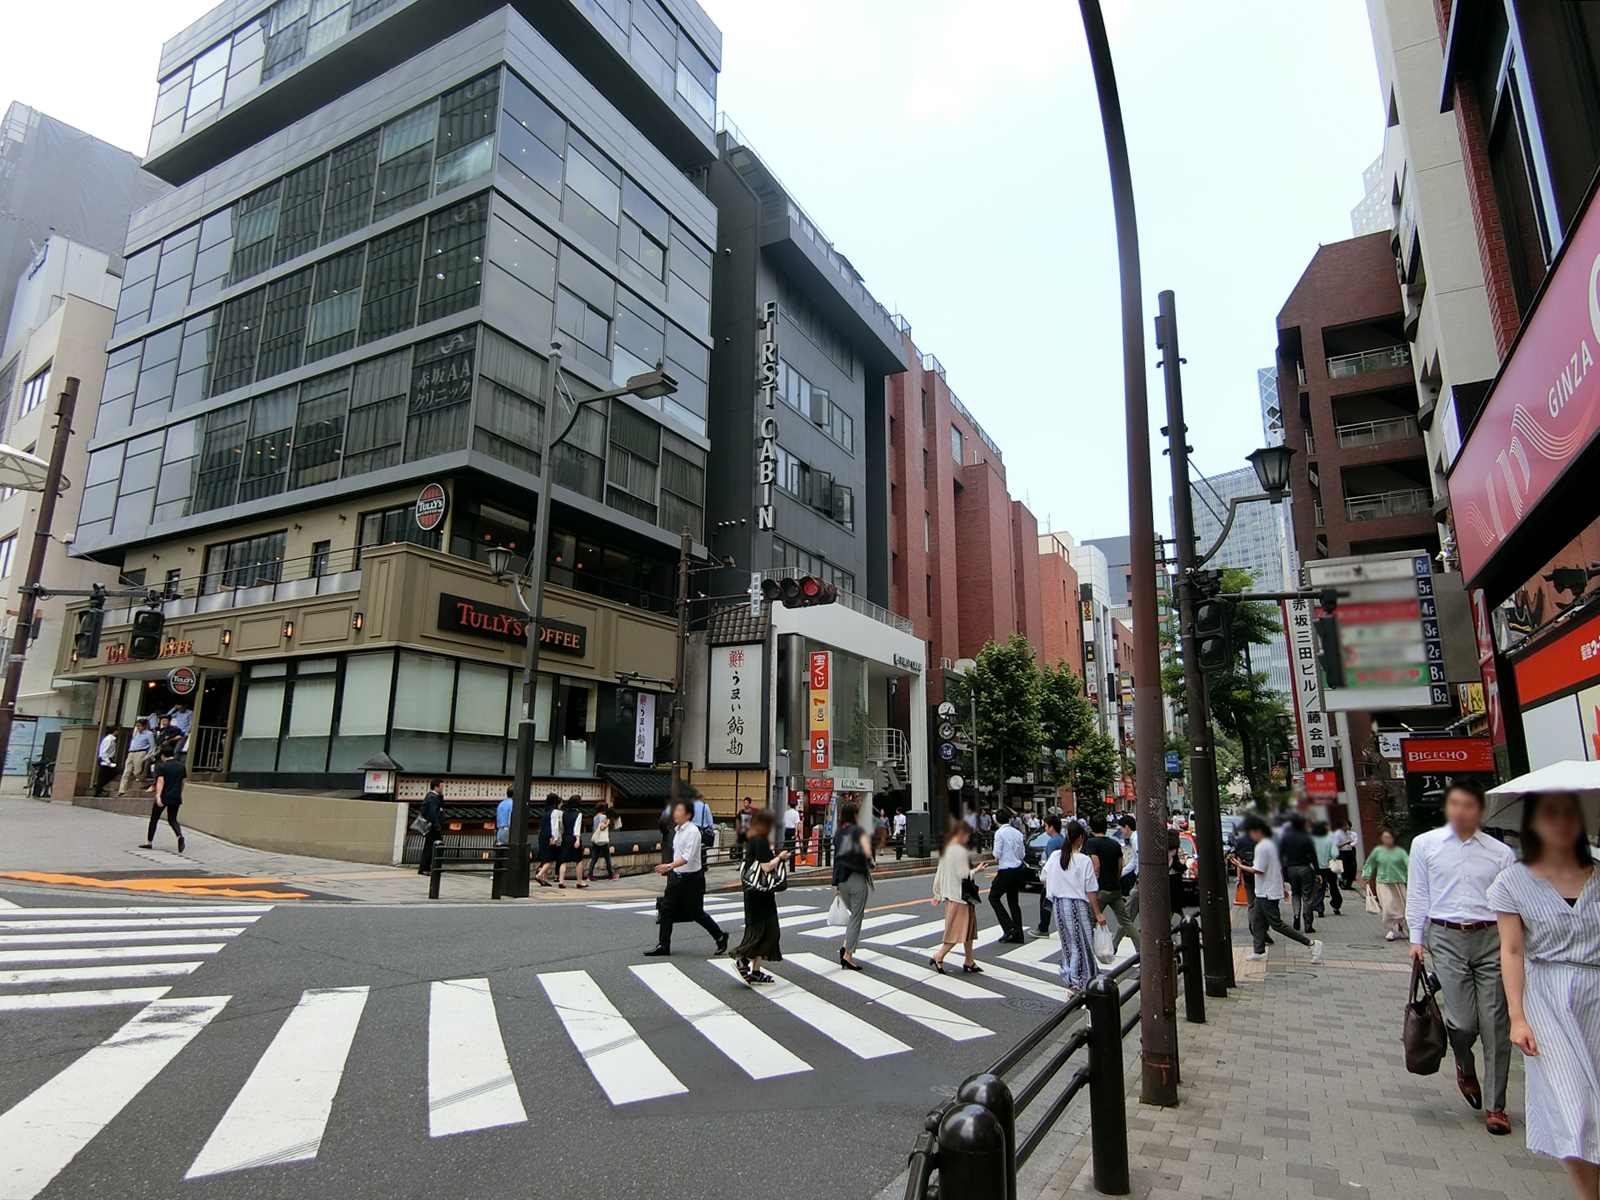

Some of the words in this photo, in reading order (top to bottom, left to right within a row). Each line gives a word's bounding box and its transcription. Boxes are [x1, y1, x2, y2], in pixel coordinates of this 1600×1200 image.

[761, 300, 776, 406] FIRST
[1548, 340, 1594, 418] GINZA
[414, 380, 471, 410] クリニック
[759, 417, 776, 530] CABIN
[418, 500, 443, 512] TULLY'S
[1415, 560, 1429, 573] 6F
[1418, 580, 1431, 594] 5F
[1421, 602, 1434, 615] 4F
[456, 602, 523, 637] TULLY'S
[1424, 623, 1438, 637] 3F
[1428, 644, 1441, 658] 2F
[813, 654, 826, 688] 宝くじ
[1430, 666, 1444, 680] B1
[1433, 688, 1447, 702] B2
[812, 737, 825, 764] BIG
[1408, 751, 1432, 762] BIG
[1433, 750, 1468, 761] ECHO
